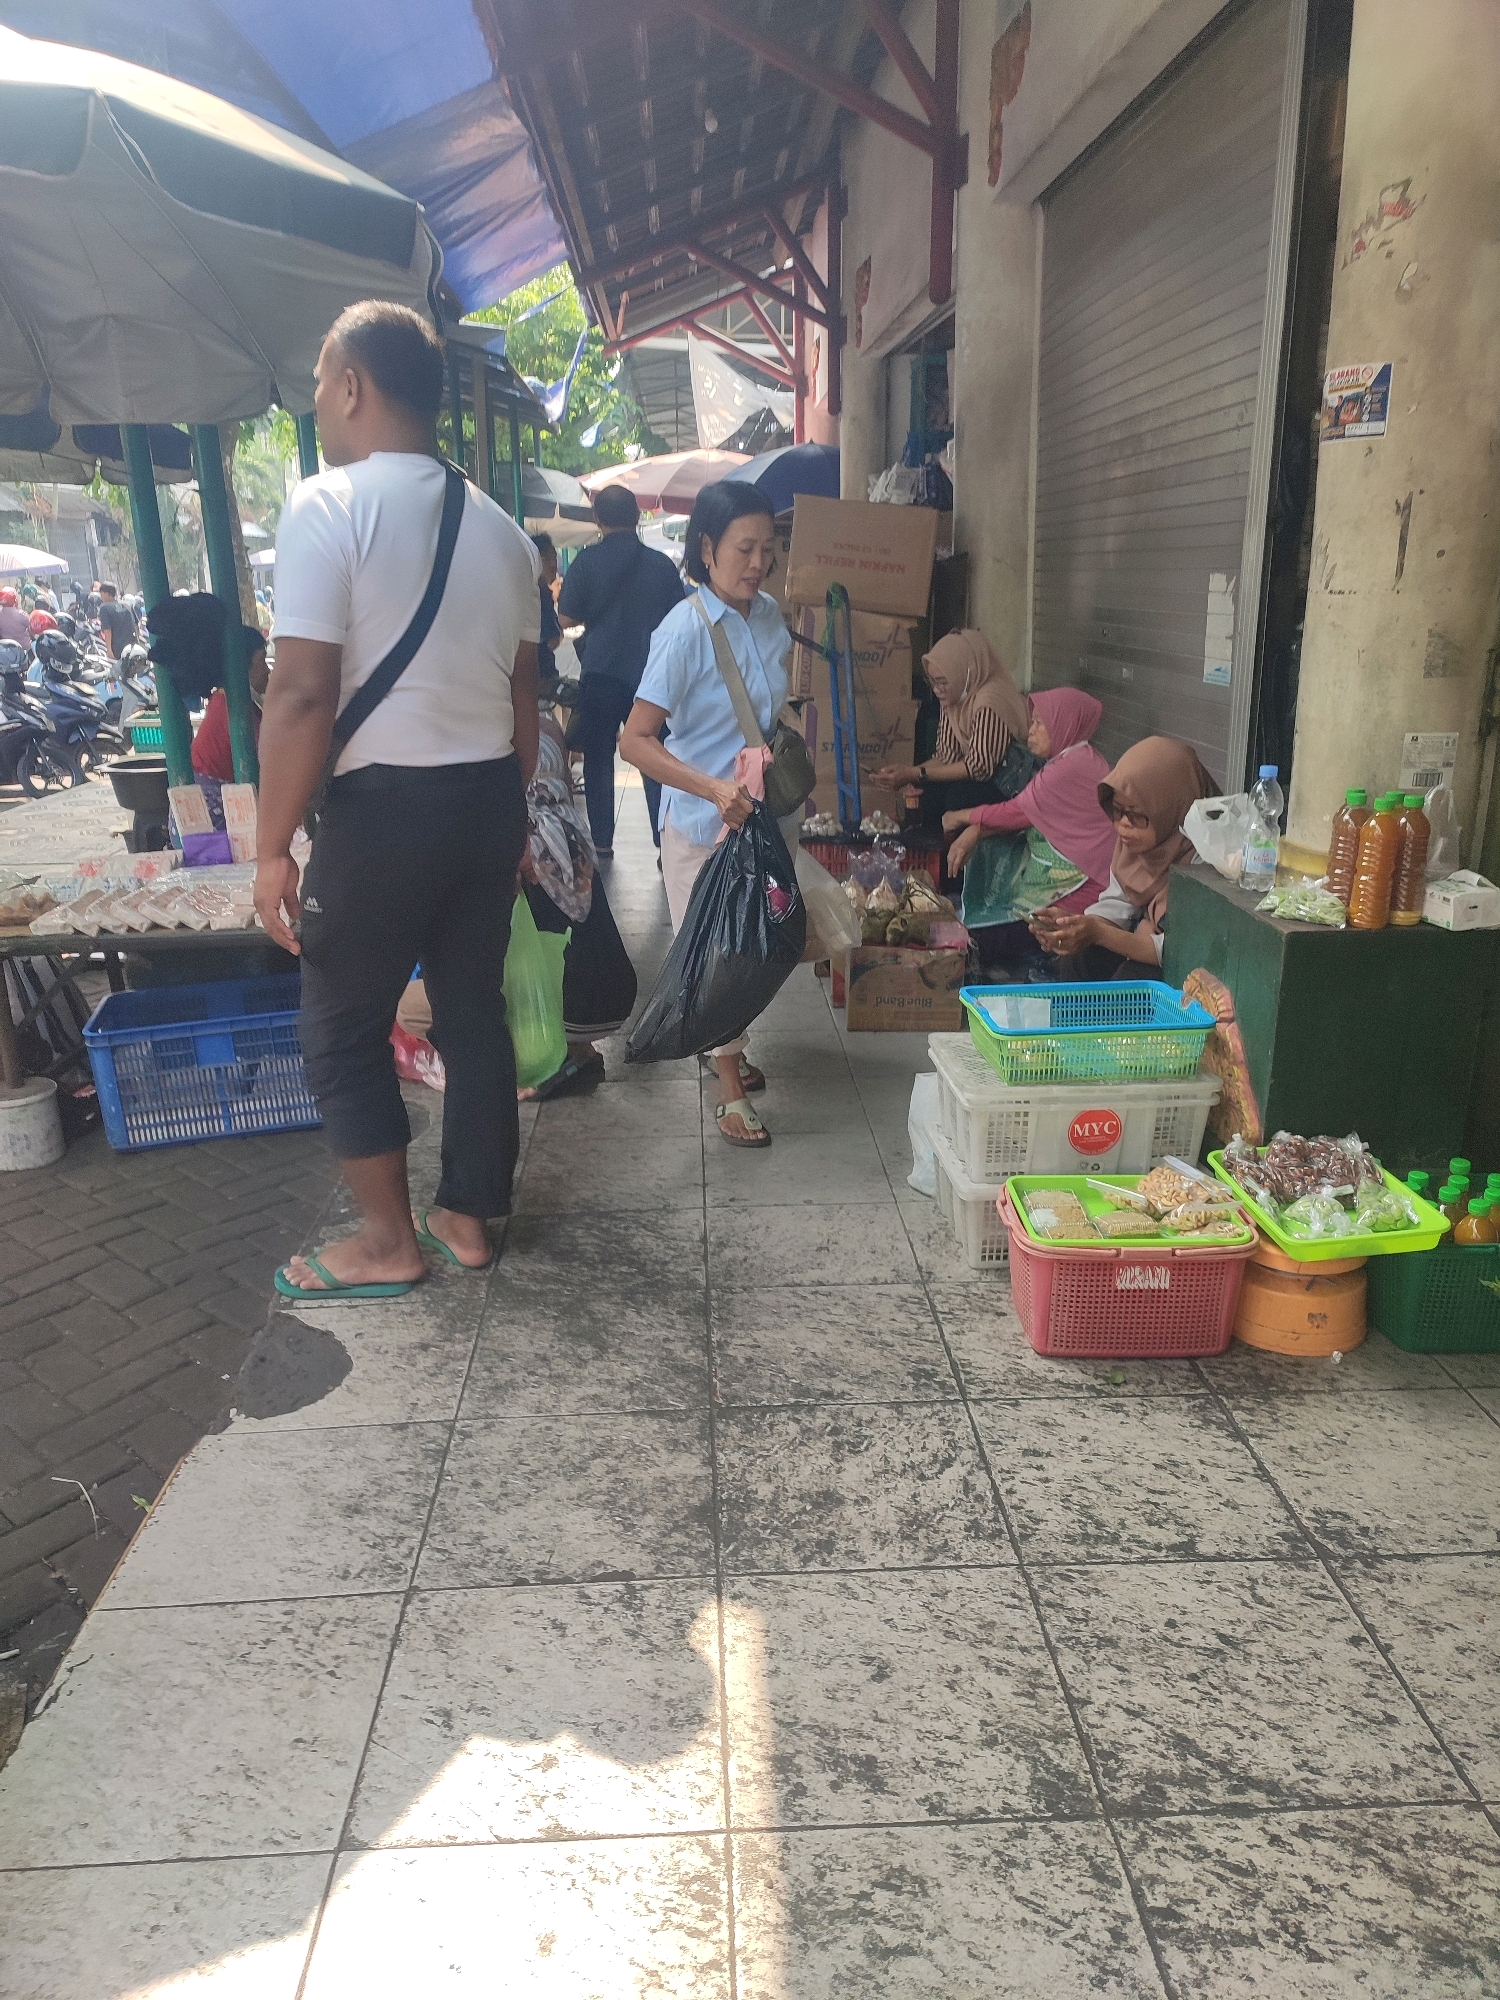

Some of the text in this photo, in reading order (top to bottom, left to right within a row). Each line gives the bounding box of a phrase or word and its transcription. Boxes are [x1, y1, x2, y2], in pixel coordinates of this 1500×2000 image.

[815, 554, 906, 575] NAPKIN REFILL
[875, 996, 932, 1008] Blue Band
[1073, 1120, 1117, 1138] MYC
